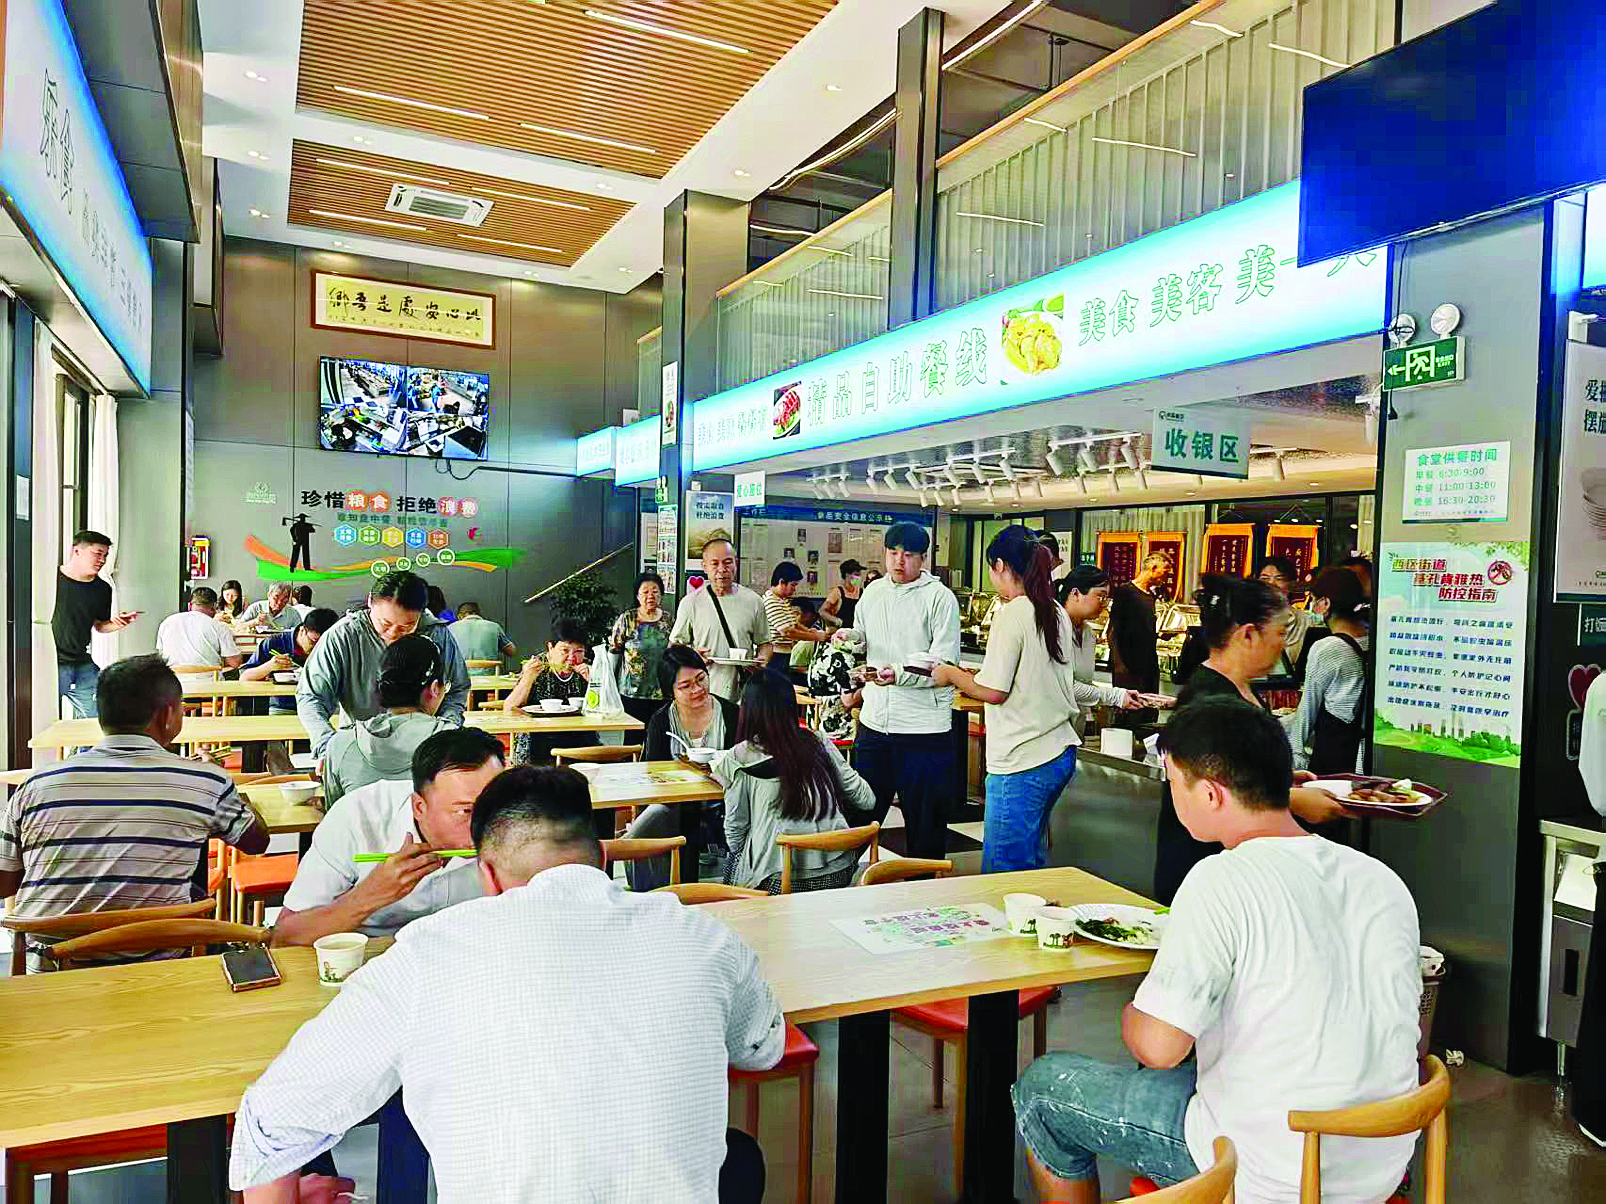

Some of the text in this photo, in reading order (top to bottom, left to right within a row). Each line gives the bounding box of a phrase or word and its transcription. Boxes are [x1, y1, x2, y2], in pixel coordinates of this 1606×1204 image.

[1079, 290, 1138, 346] 美食
[1149, 263, 1222, 327] 美客
[809, 328, 988, 427] 精品自助餐线
[1165, 428, 1239, 463] 收银区
[1417, 449, 1497, 466] 食堂供餐时间
[301, 490, 388, 510] 珍惜粮食
[397, 496, 476, 515] 拒绝浪费
[1413, 572, 1484, 587] 基孔肯雅热
[1438, 587, 1498, 602] 防控指南
